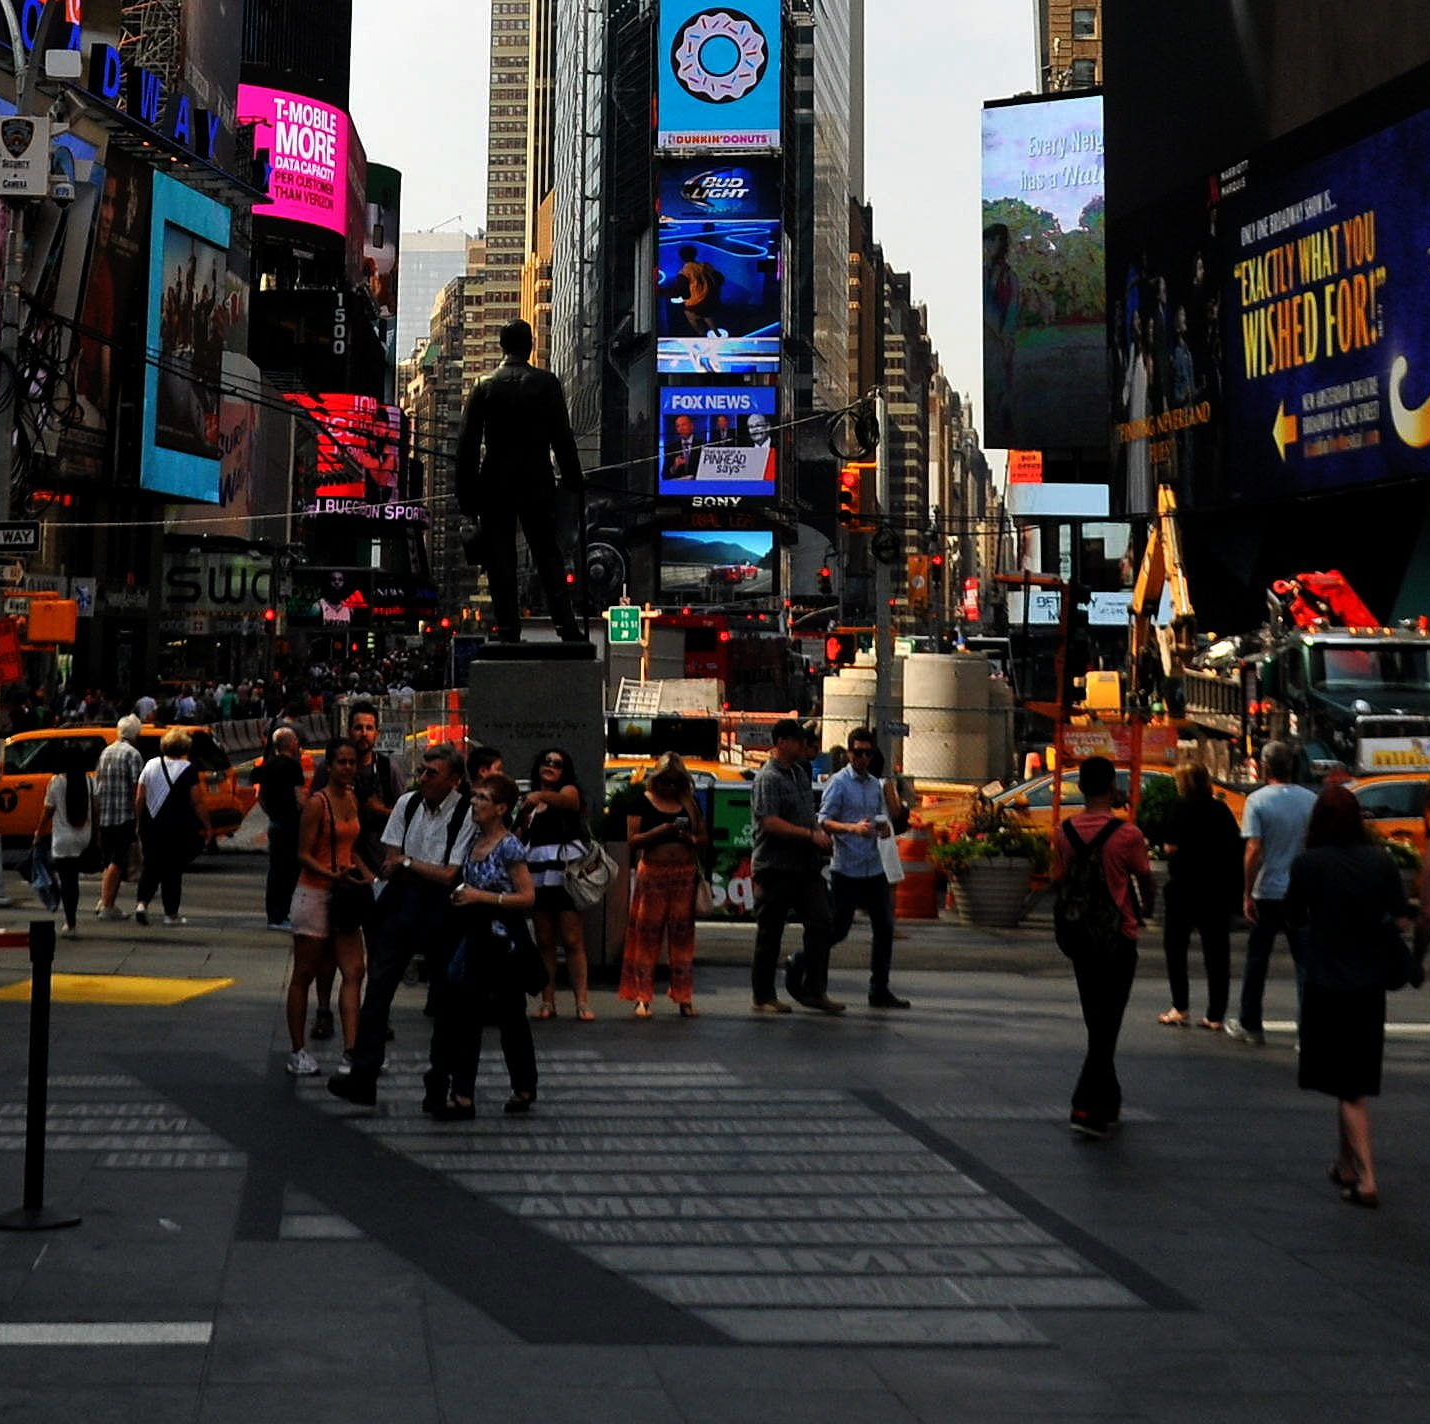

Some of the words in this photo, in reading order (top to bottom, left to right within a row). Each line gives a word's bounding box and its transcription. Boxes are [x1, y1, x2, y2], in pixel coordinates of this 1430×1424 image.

[274, 97, 337, 135] T-MOBILE
[276, 121, 336, 167] MORE
[723, 135, 767, 143] DONUTS
[1028, 136, 1067, 159] Every
[275, 156, 301, 173] DATA
[301, 162, 334, 182] CAPACITY
[275, 171, 294, 185] PER
[296, 175, 334, 195] CUSTOMER
[691, 188, 750, 199] LIGHT
[701, 177, 743, 188] BUD
[275, 185, 302, 201] THAN
[304, 191, 334, 210] VERIZON
[1297, 224, 1340, 286] WHAT
[1342, 210, 1376, 269] YOU
[332, 292, 345, 356] 1500
[1242, 290, 1319, 381] WISHED
[671, 395, 703, 409] FOX
[705, 395, 750, 409] NEWS
[703, 454, 746, 465] PINHEAD
[692, 496, 742, 507] SONY
[3, 531, 30, 542] WAY
